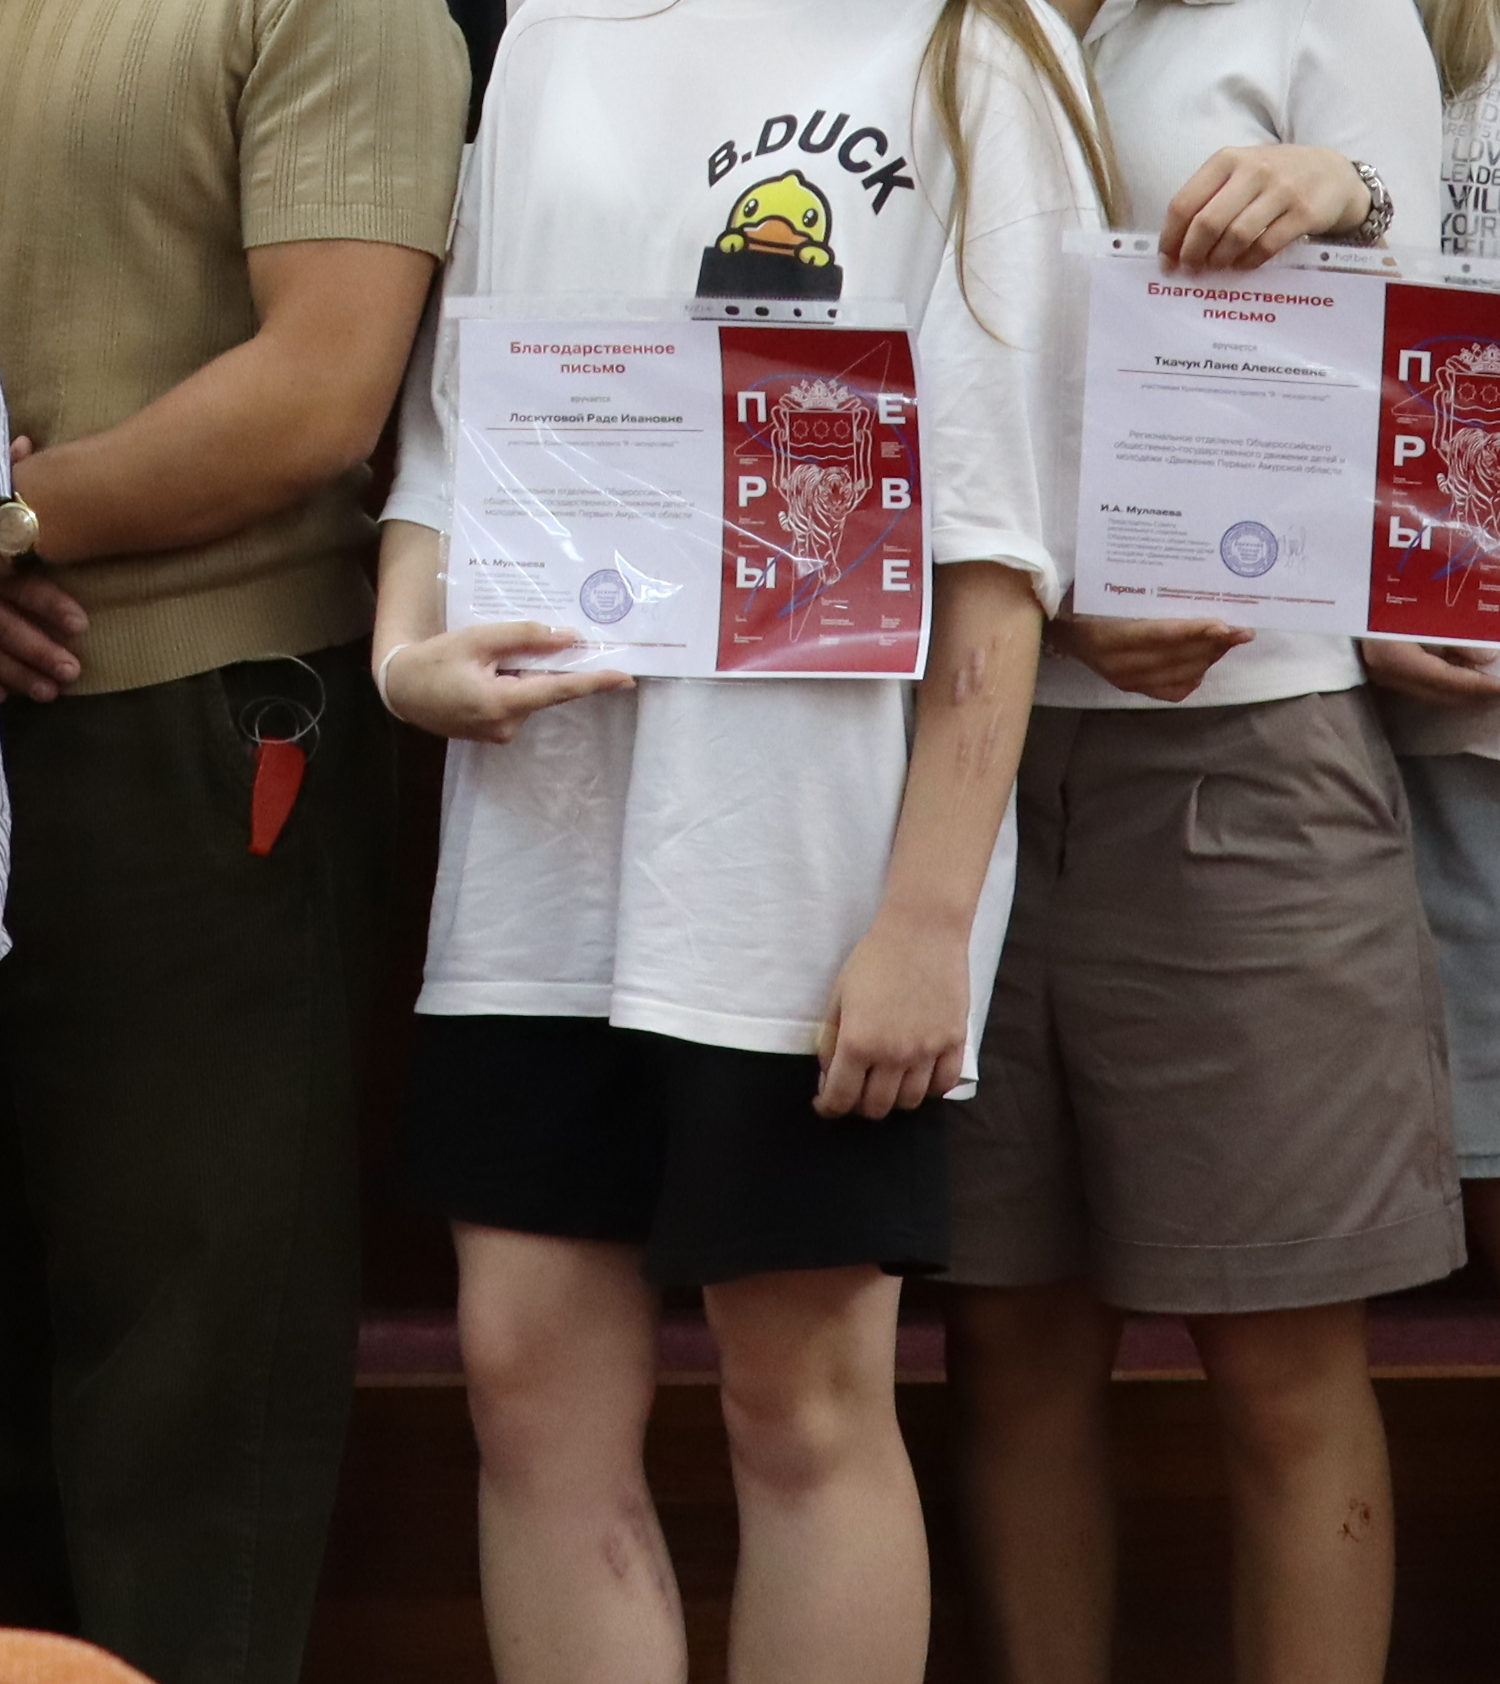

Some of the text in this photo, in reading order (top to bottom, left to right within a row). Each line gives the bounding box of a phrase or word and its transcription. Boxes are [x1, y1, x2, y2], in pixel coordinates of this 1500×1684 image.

[707, 109, 915, 216] B.DUCK
[1148, 282, 1335, 309] Благодарственное
[1202, 306, 1277, 324] письмо
[509, 341, 675, 356] Благодарственное
[1153, 355, 1201, 370] Ткачук
[1202, 359, 1238, 372] Лане
[560, 362, 626, 374] письмо
[1398, 349, 1431, 382] П
[509, 412, 683, 424] Лоскутовой Раде Ивановне
[737, 391, 907, 425] П Е
[1393, 434, 1426, 468] Р
[737, 476, 912, 509] Р В
[1388, 515, 1432, 551] Ы
[736, 556, 911, 592] Ы Е
